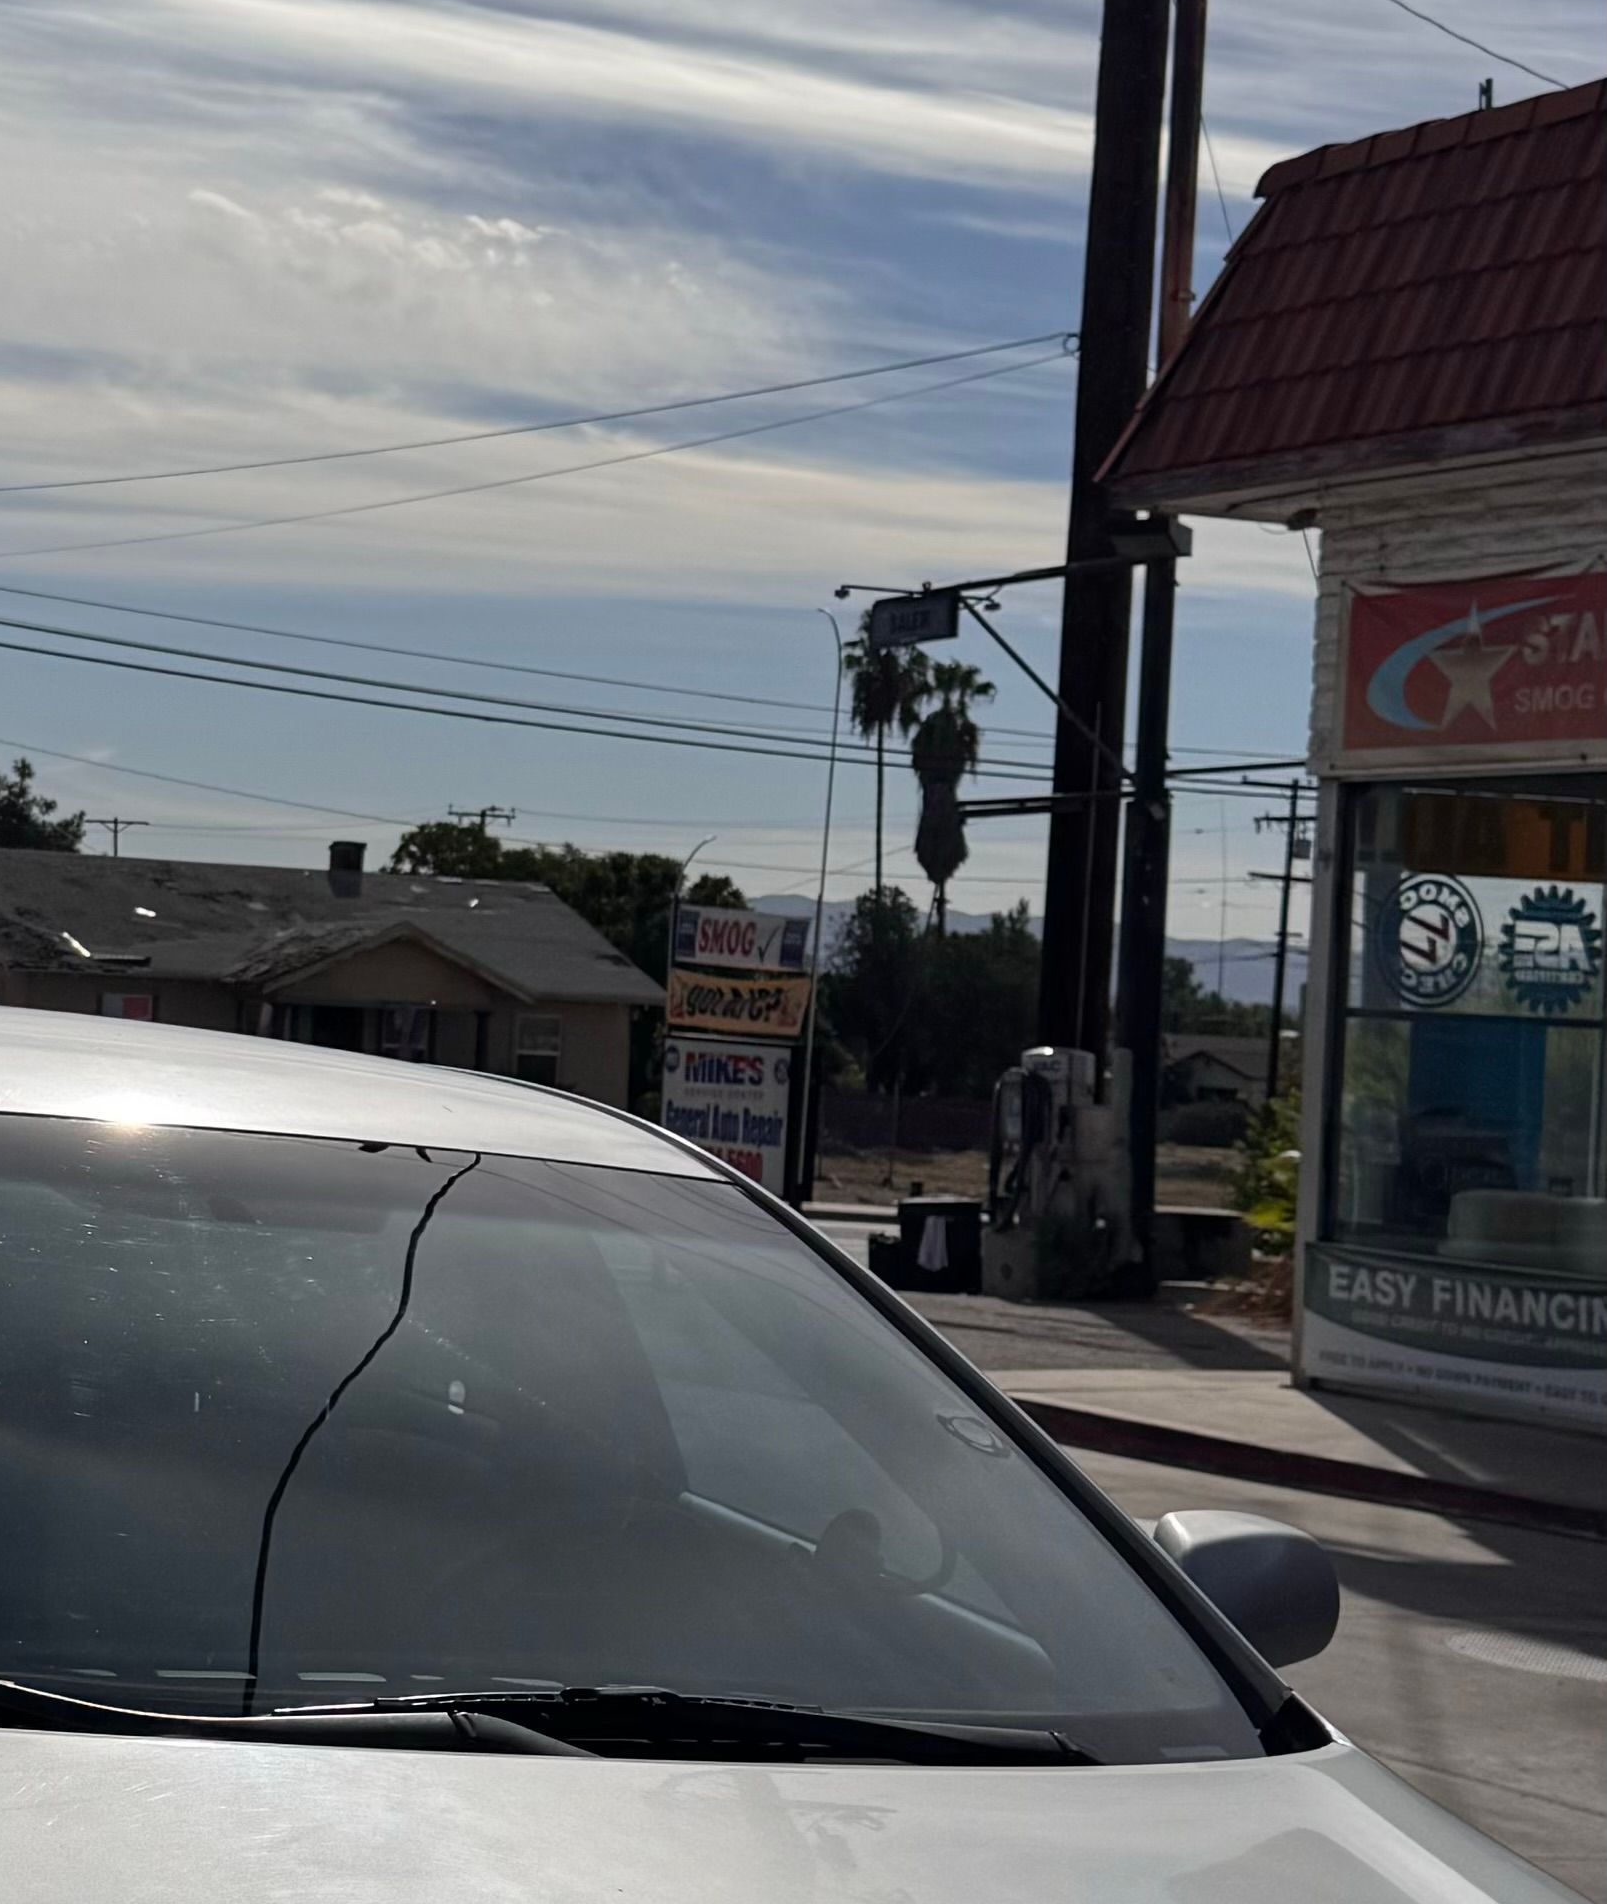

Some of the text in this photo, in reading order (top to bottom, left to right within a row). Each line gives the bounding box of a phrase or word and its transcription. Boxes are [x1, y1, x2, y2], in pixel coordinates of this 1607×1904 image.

[1521, 610, 1605, 665] STA
[1514, 684, 1595, 713] SMOG
[698, 917, 757, 956] SMOG
[685, 1052, 764, 1086] MIKE'S
[666, 1099, 783, 1148] General Auto Repair
[1329, 1262, 1416, 1308] EASY
